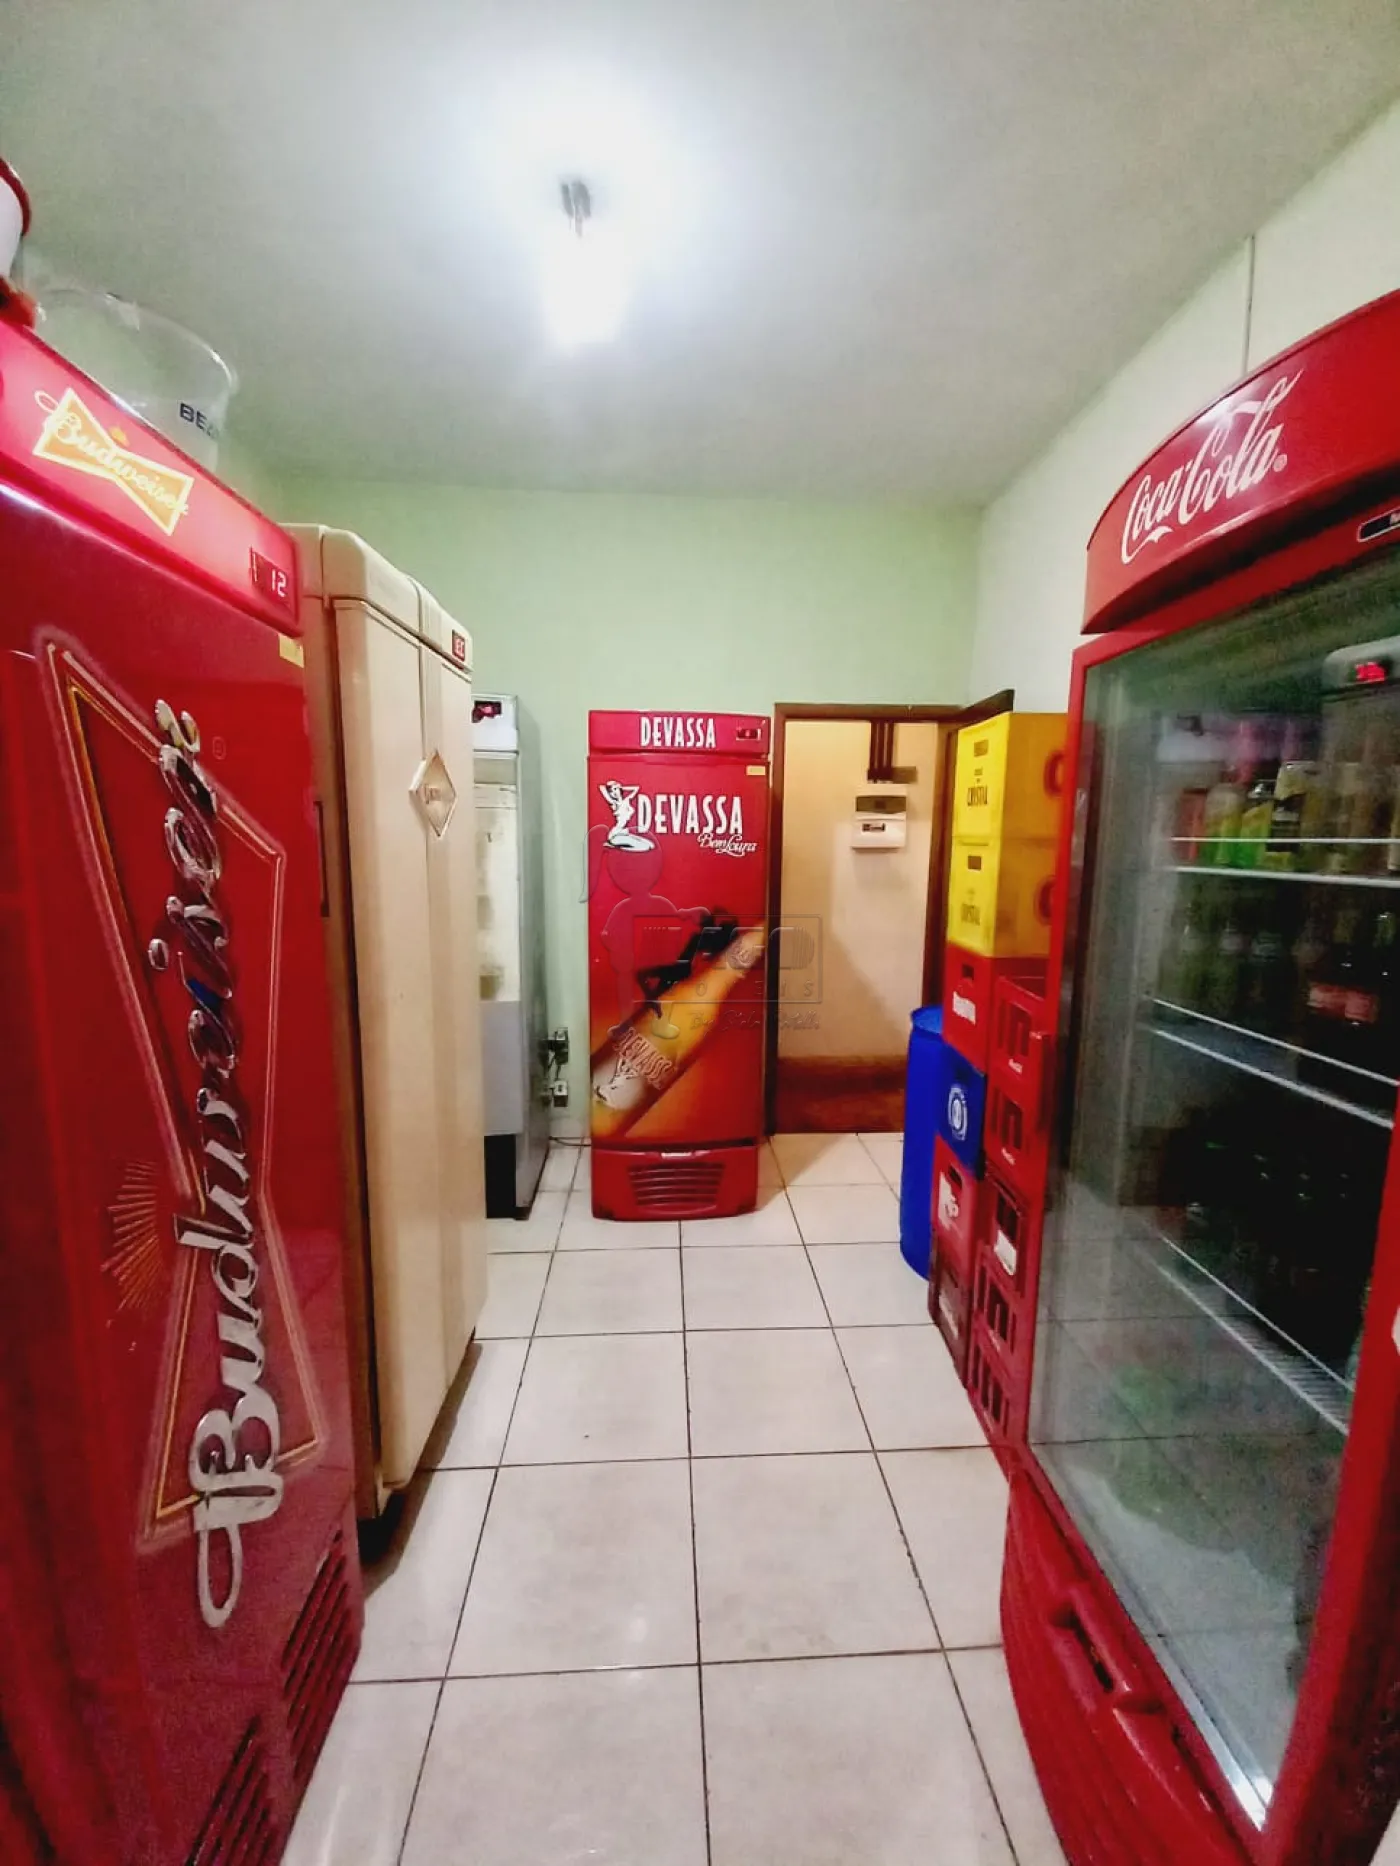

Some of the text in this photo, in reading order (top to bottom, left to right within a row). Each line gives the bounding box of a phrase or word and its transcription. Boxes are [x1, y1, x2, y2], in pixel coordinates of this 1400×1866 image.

[34, 390, 189, 516] Budweiser
[640, 716, 717, 748] DEVASSA
[636, 794, 743, 835] DEVASSA
[148, 698, 285, 1629] Budweiser
